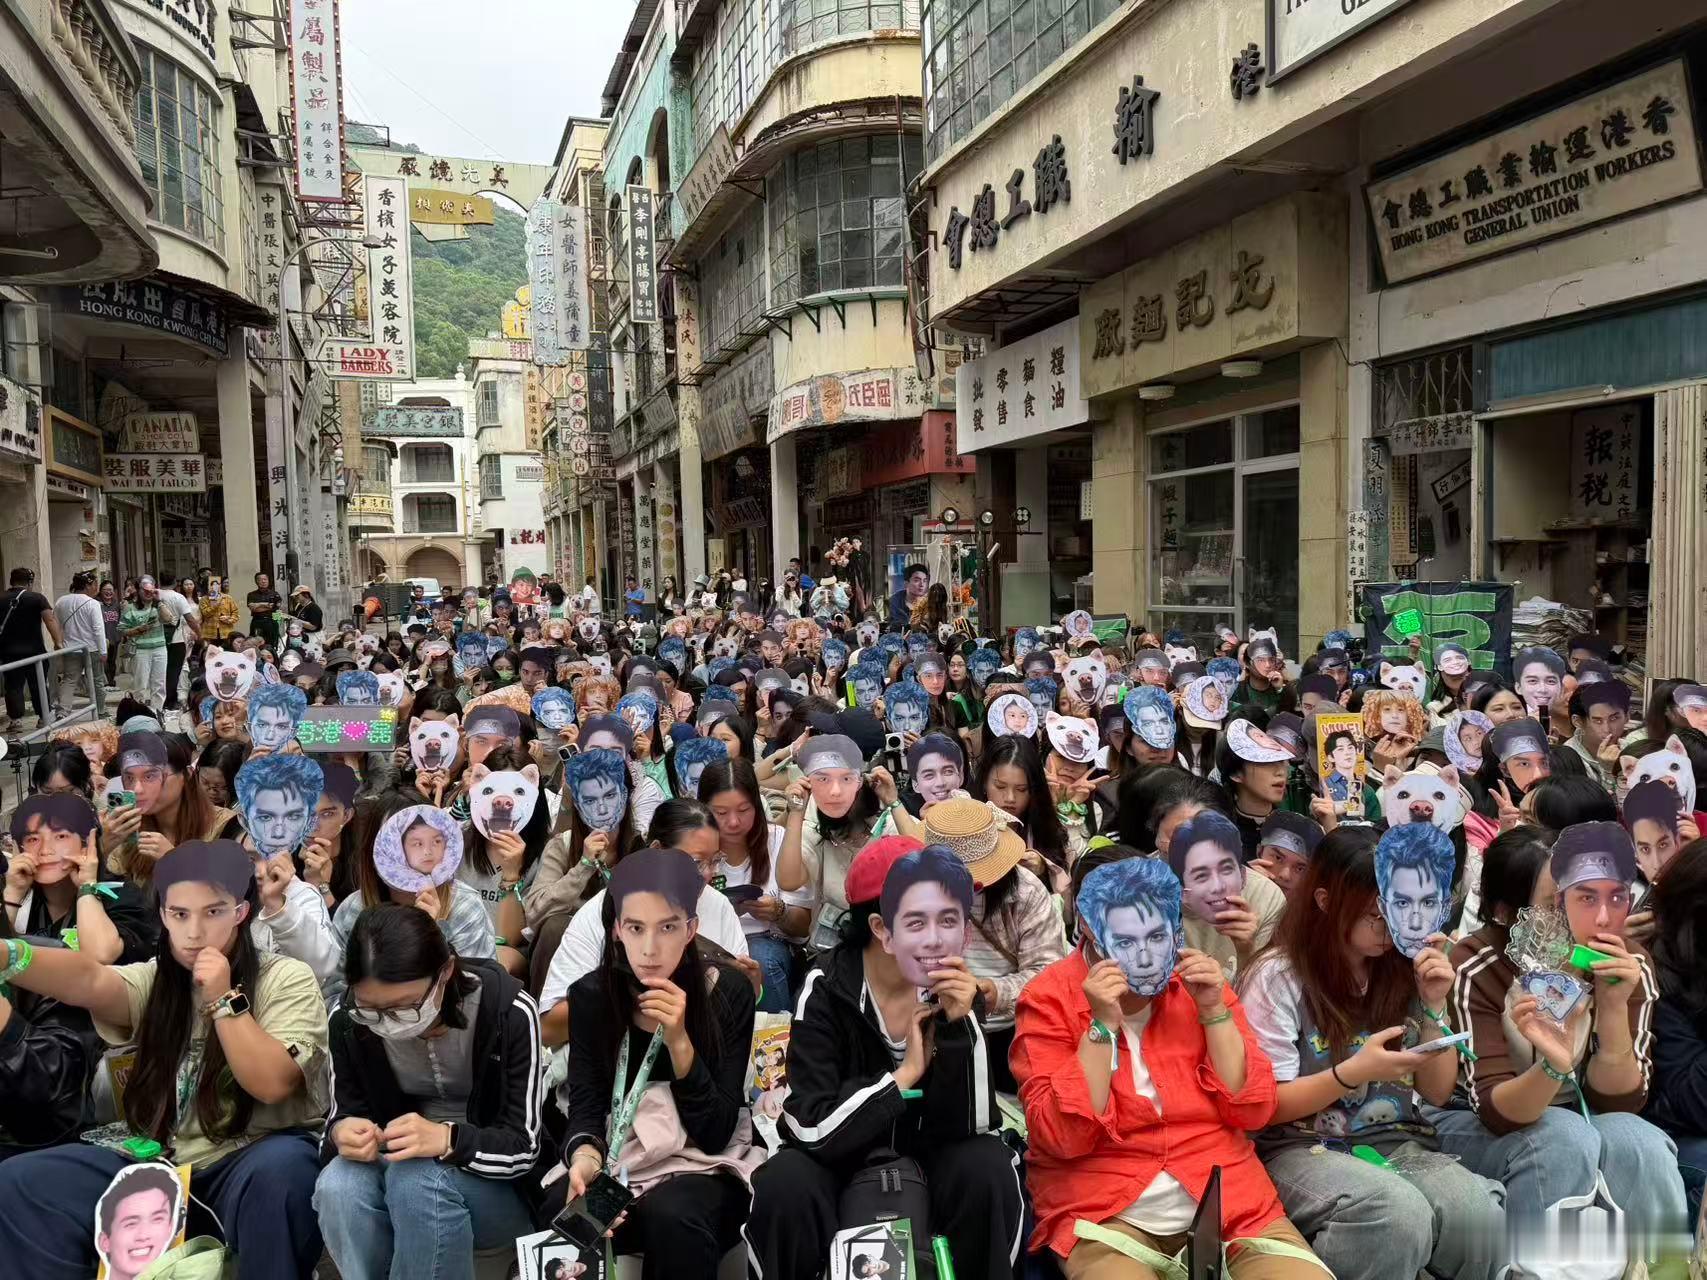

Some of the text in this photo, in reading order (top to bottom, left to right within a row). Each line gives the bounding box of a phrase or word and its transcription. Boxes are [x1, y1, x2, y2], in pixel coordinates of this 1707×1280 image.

[1391, 141, 1676, 251] HONG KONG TRANSPORTATION WORKERS
[1463, 195, 1580, 246] GENERAL UNION
[80, 300, 122, 317] HONG
[126, 309, 160, 327] KONG
[163, 319, 198, 339] KWONG
[340, 347, 391, 360] LADY
[341, 359, 393, 374] BARBERS
[104, 459, 200, 478] 華美服裝
